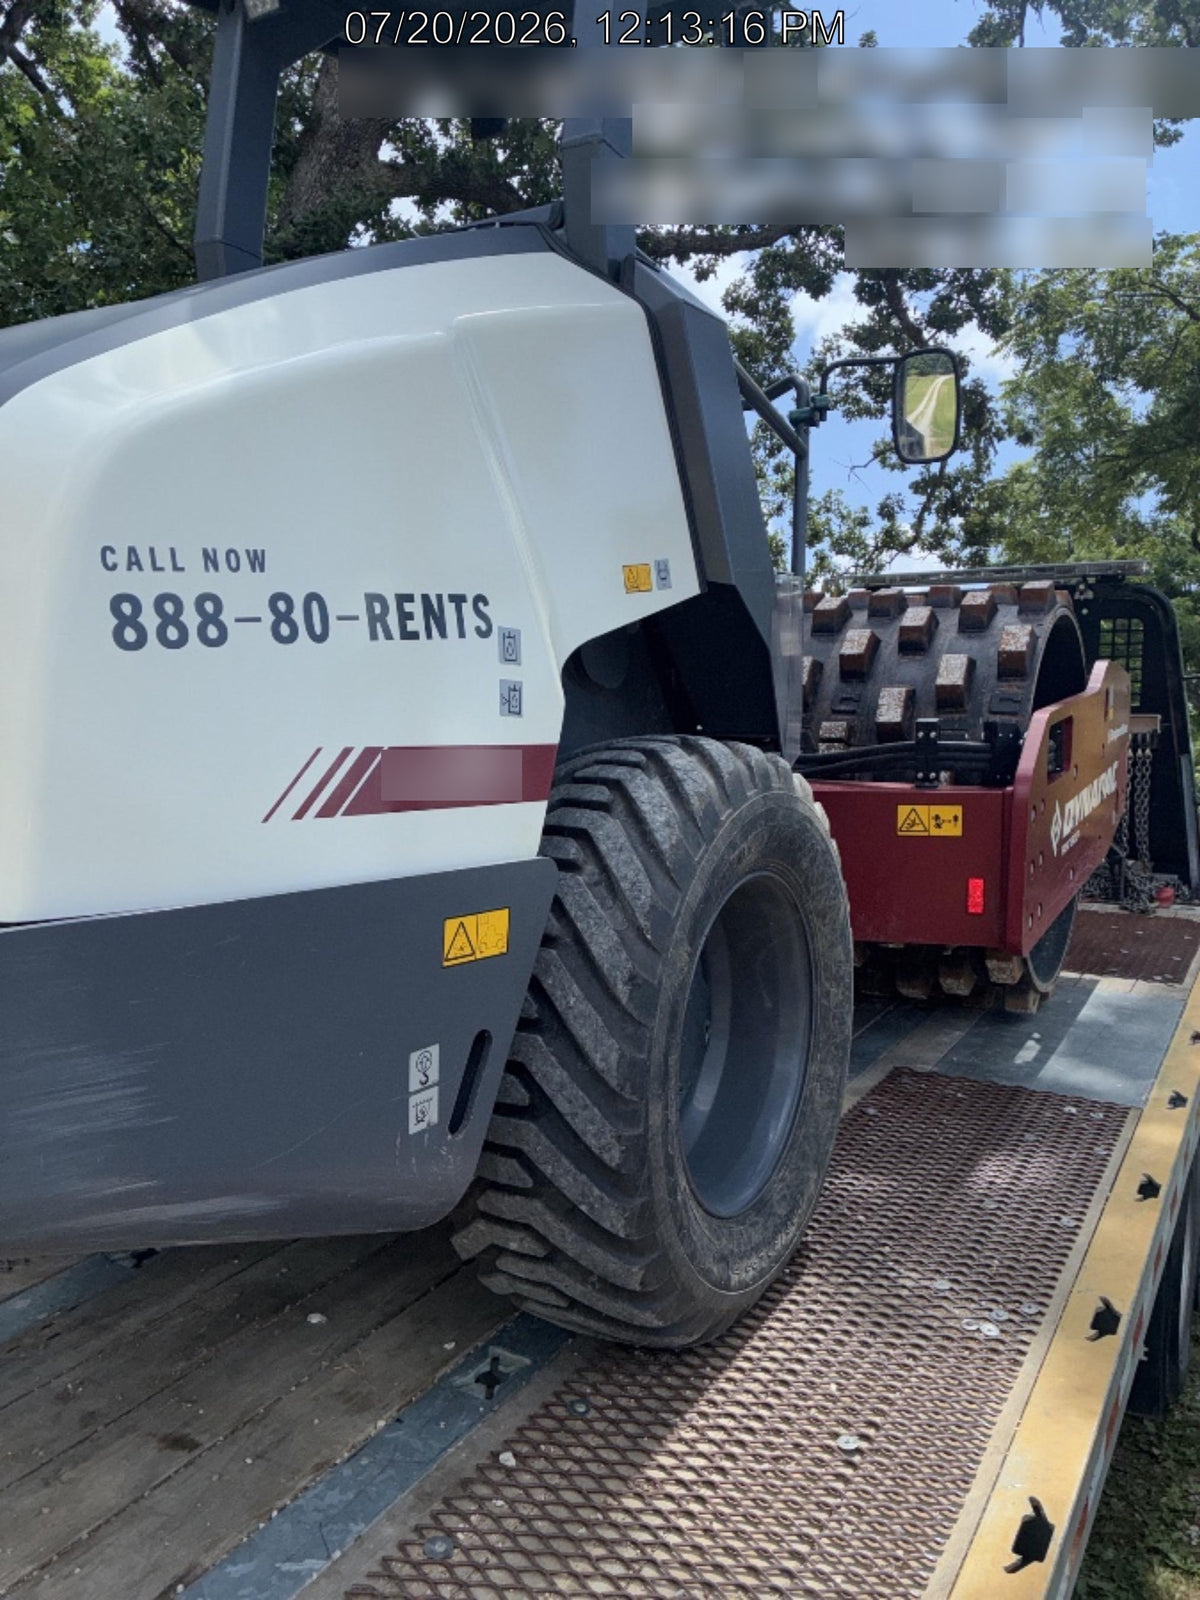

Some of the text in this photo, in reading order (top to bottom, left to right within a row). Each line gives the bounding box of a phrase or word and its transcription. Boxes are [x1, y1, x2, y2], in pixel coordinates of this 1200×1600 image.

[100, 545, 266, 573] CALL NOW
[109, 591, 493, 651] 888-80-RENTS
